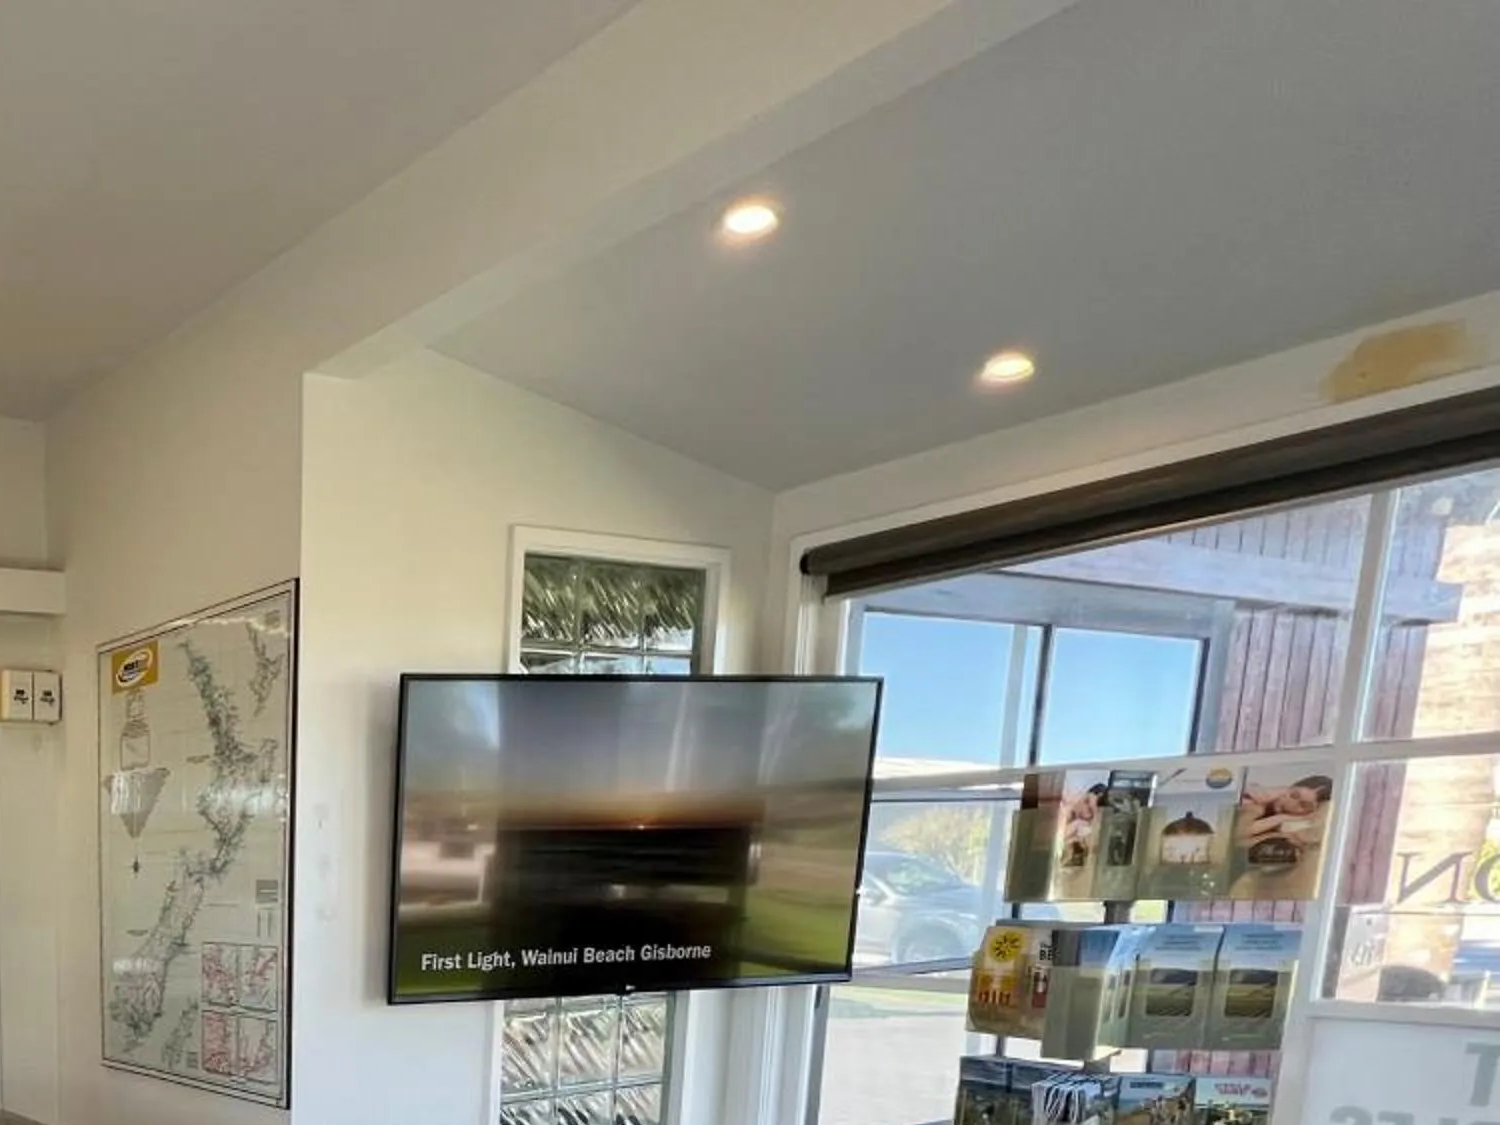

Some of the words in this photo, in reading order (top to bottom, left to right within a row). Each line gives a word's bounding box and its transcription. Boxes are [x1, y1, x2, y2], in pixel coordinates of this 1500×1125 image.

[421, 952, 462, 971] First
[467, 951, 516, 971] Light,
[521, 947, 578, 966] Wainui
[583, 945, 635, 963] Beach
[640, 943, 712, 962] Gisborne
